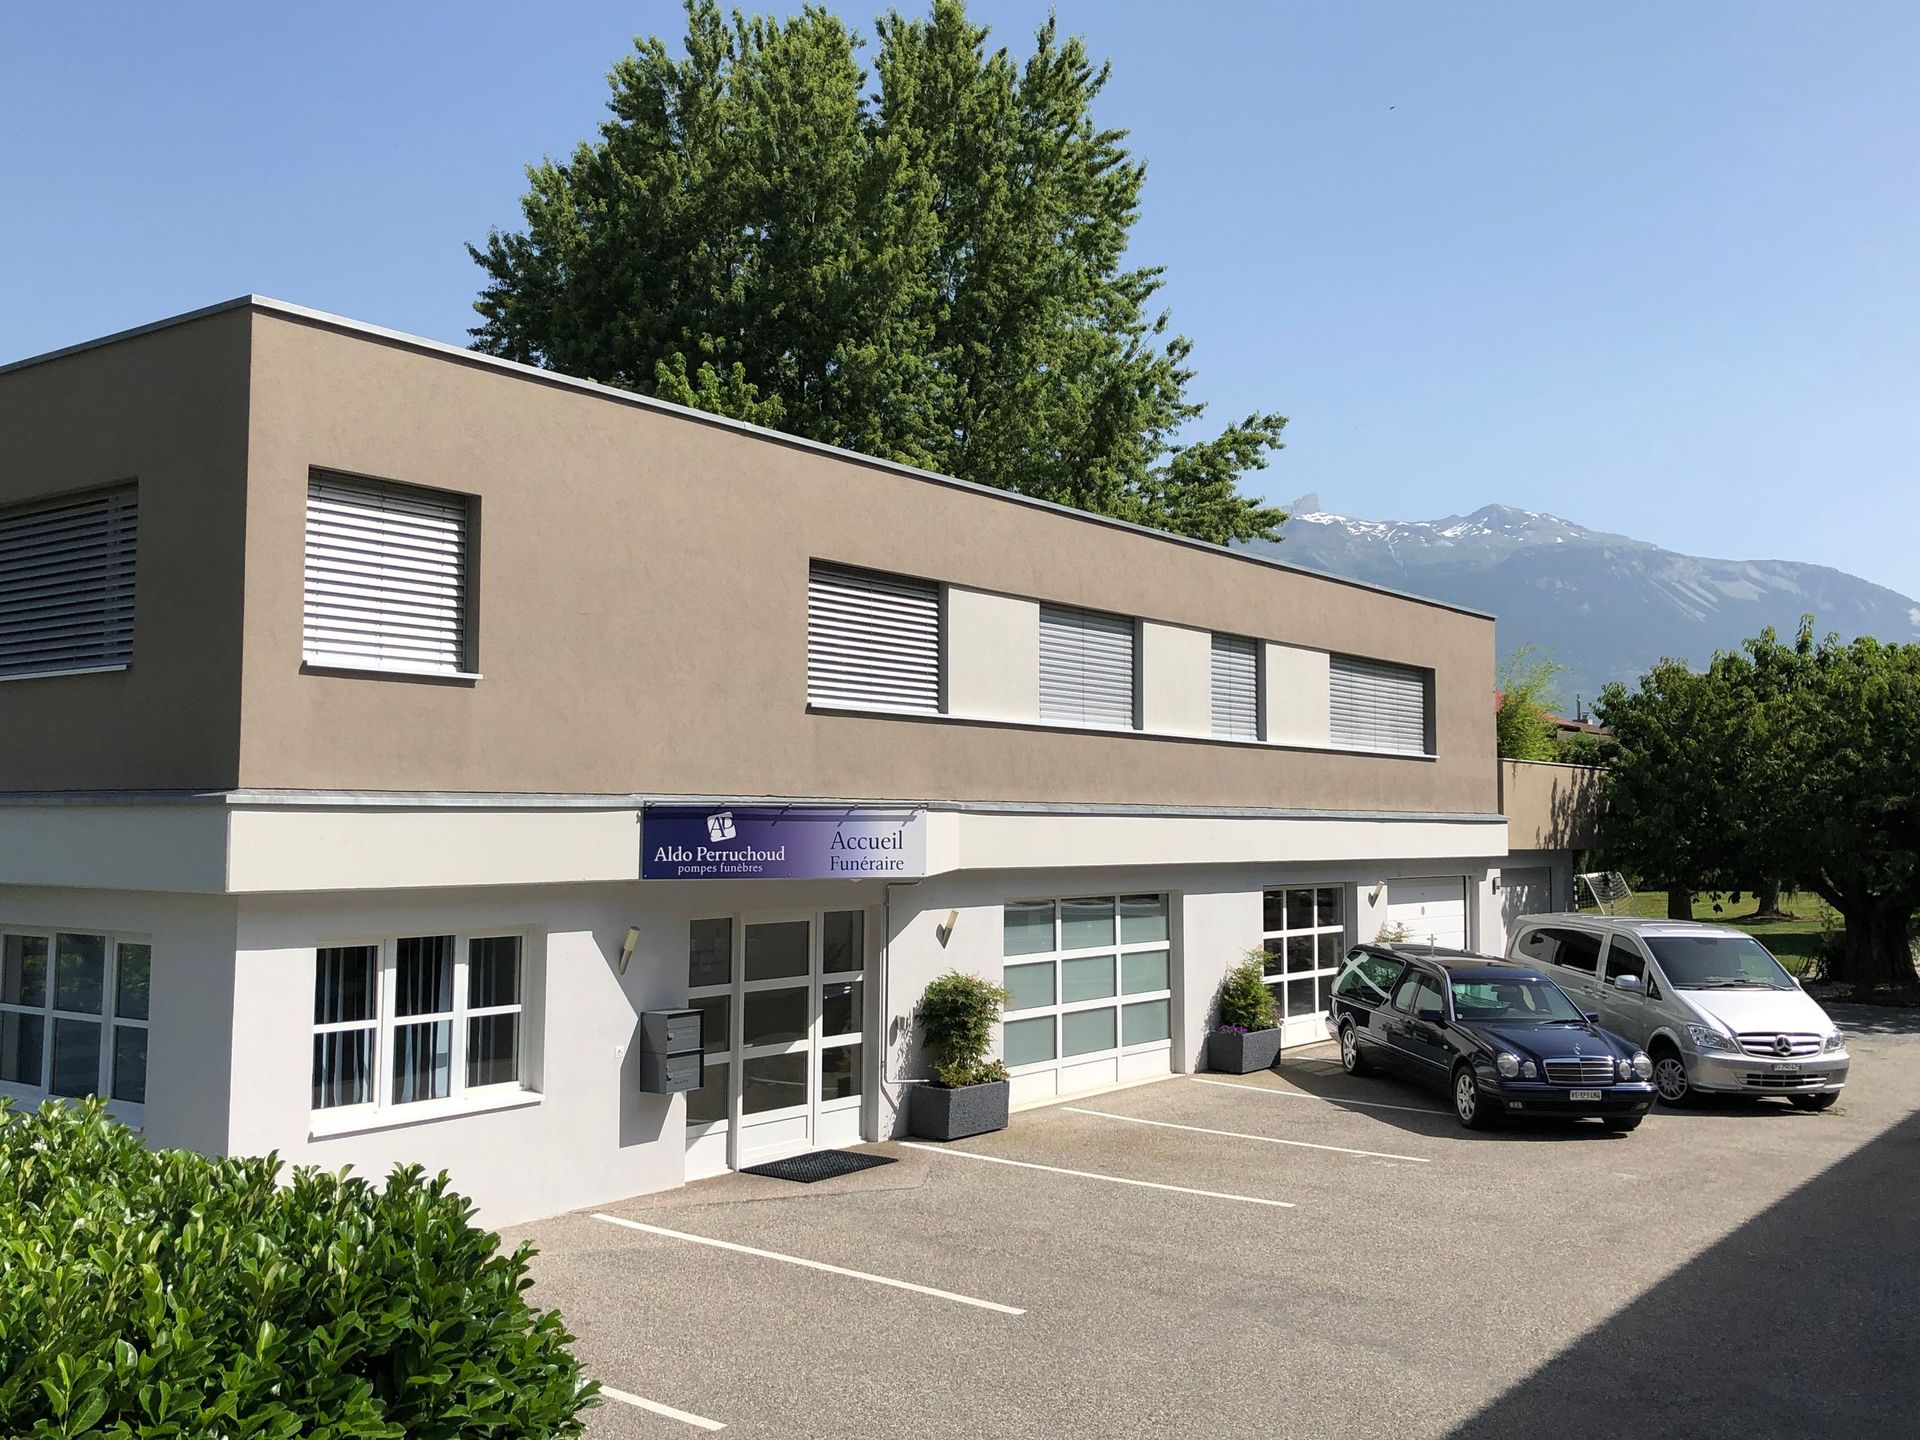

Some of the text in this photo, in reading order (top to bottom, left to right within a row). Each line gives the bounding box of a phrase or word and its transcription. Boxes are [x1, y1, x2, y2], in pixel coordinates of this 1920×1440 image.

[830, 830, 904, 850] Accueil
[654, 845, 785, 862] Aldo Perruchoud
[678, 862, 763, 875] pompes funèbres
[830, 855, 905, 871] Funéraire
